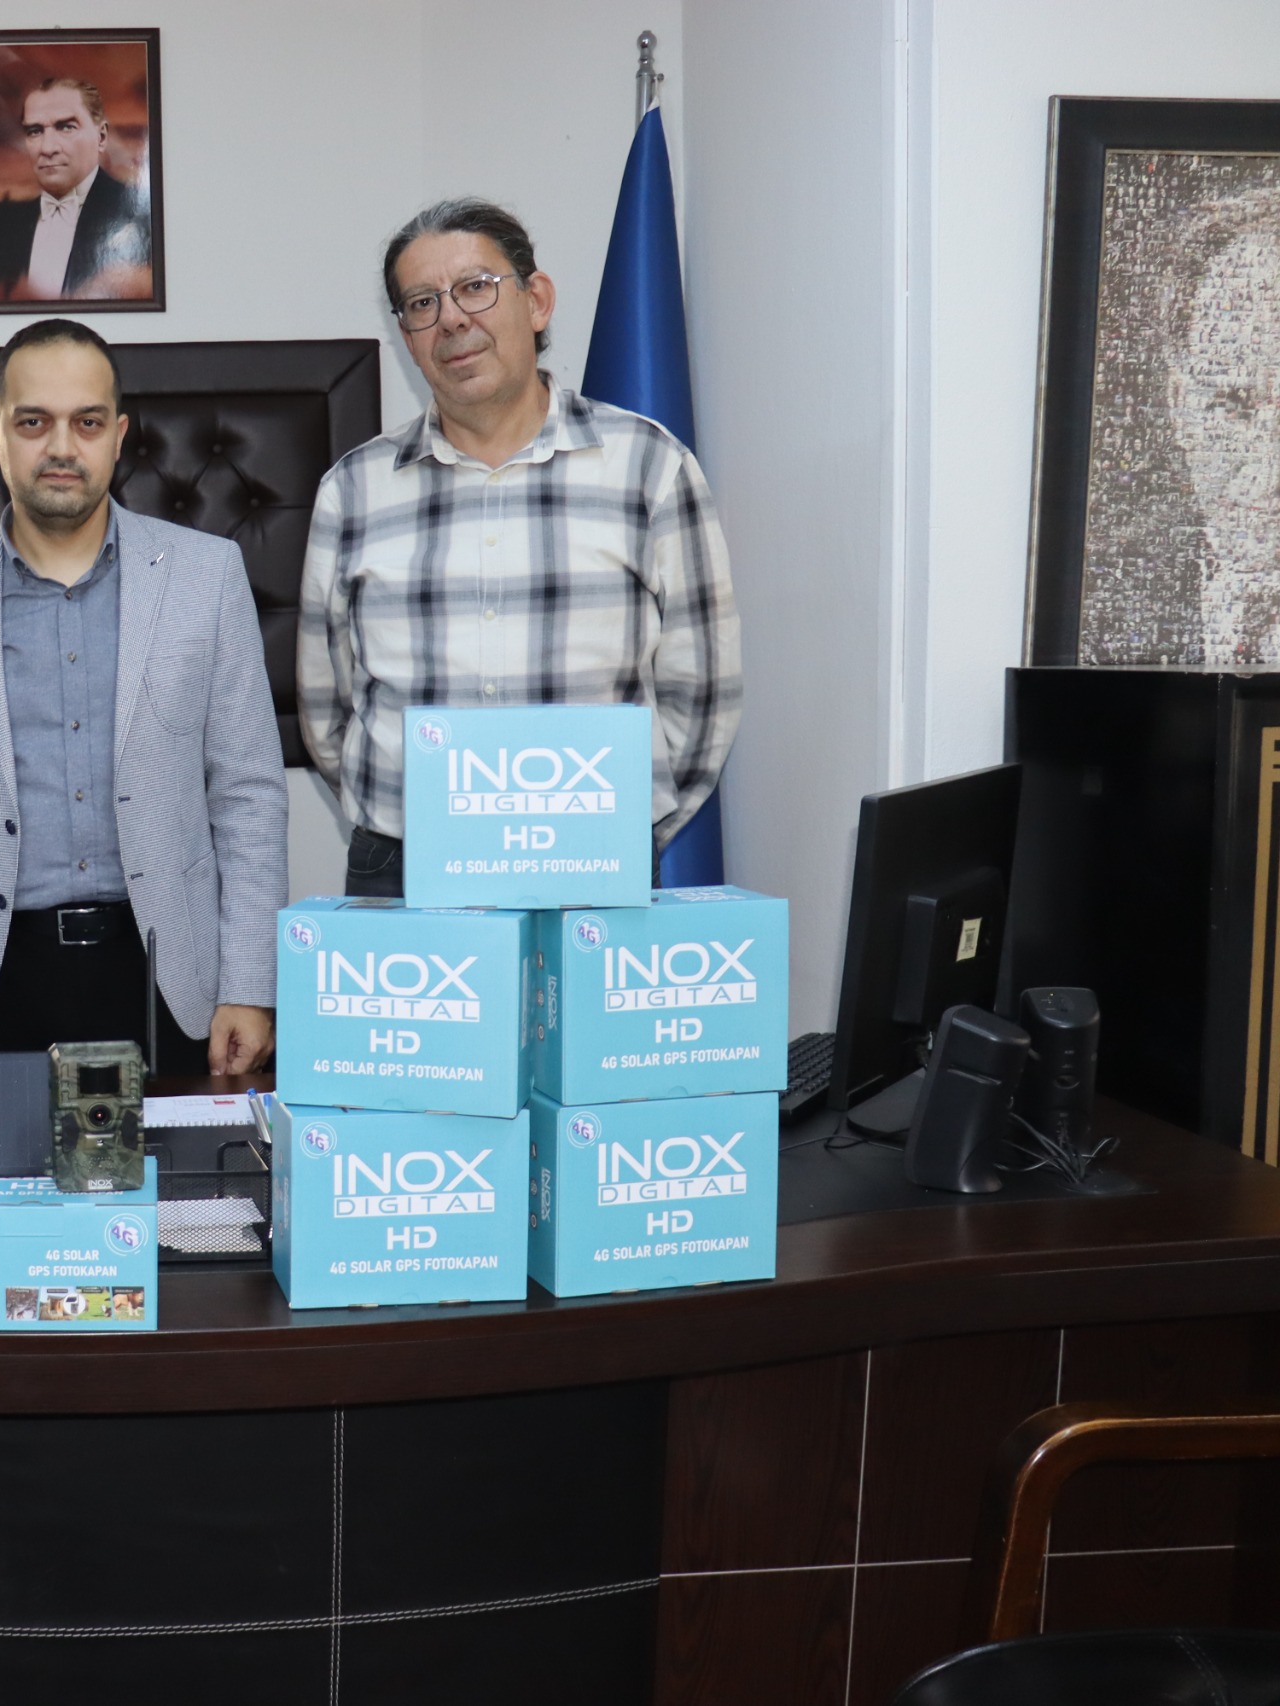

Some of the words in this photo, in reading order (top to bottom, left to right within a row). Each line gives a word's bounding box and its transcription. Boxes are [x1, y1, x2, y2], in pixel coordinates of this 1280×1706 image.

[420, 722, 443, 744] 4G
[448, 746, 614, 791] INOX
[451, 794, 614, 812] DIGITAL
[504, 825, 556, 850] HD
[445, 861, 462, 873] 4G
[467, 860, 509, 873] SOLAR
[513, 860, 539, 872] GPS
[543, 859, 619, 872] FOTOKAPAN
[290, 923, 313, 945] 4G
[577, 922, 601, 945] 4G
[317, 950, 480, 999] INOX
[605, 939, 756, 989] INOX
[320, 996, 478, 1020] DIGITAL
[607, 984, 755, 1009] DIGITAL
[370, 1029, 421, 1054] HD
[655, 1017, 703, 1043] HD
[601, 1056, 617, 1069] 4G
[621, 1053, 660, 1068] SOLAR
[664, 1051, 687, 1065] GPS
[691, 1046, 760, 1063] FOTOKAPAN
[314, 1060, 329, 1072] 4G
[334, 1061, 374, 1075] SOLAR
[379, 1063, 404, 1077] GPS
[408, 1064, 483, 1081] FOTOKAPAN
[306, 1128, 329, 1150] 4G
[572, 1118, 595, 1140] 4G
[598, 1132, 746, 1183] INOX
[334, 1149, 494, 1195] INOX
[600, 1177, 745, 1203] DIGITAL
[336, 1195, 493, 1215] DIGITAL
[111, 1222, 138, 1247] 4G
[647, 1210, 694, 1235] HD
[387, 1226, 437, 1250] HD
[594, 1249, 609, 1262] 4G
[613, 1245, 651, 1260] SOLAR
[655, 1243, 678, 1256] GPS
[681, 1236, 749, 1254] FOTOKAPAN
[46, 1250, 60, 1260] 4G
[64, 1250, 99, 1260] SOLAR
[330, 1262, 346, 1274] 4G
[350, 1260, 391, 1274] SOLAR
[396, 1259, 420, 1271] GPS
[424, 1256, 498, 1270] FOTOKAPAN
[28, 1266, 50, 1277] GPS
[54, 1266, 117, 1277] FOTOKAPAN
